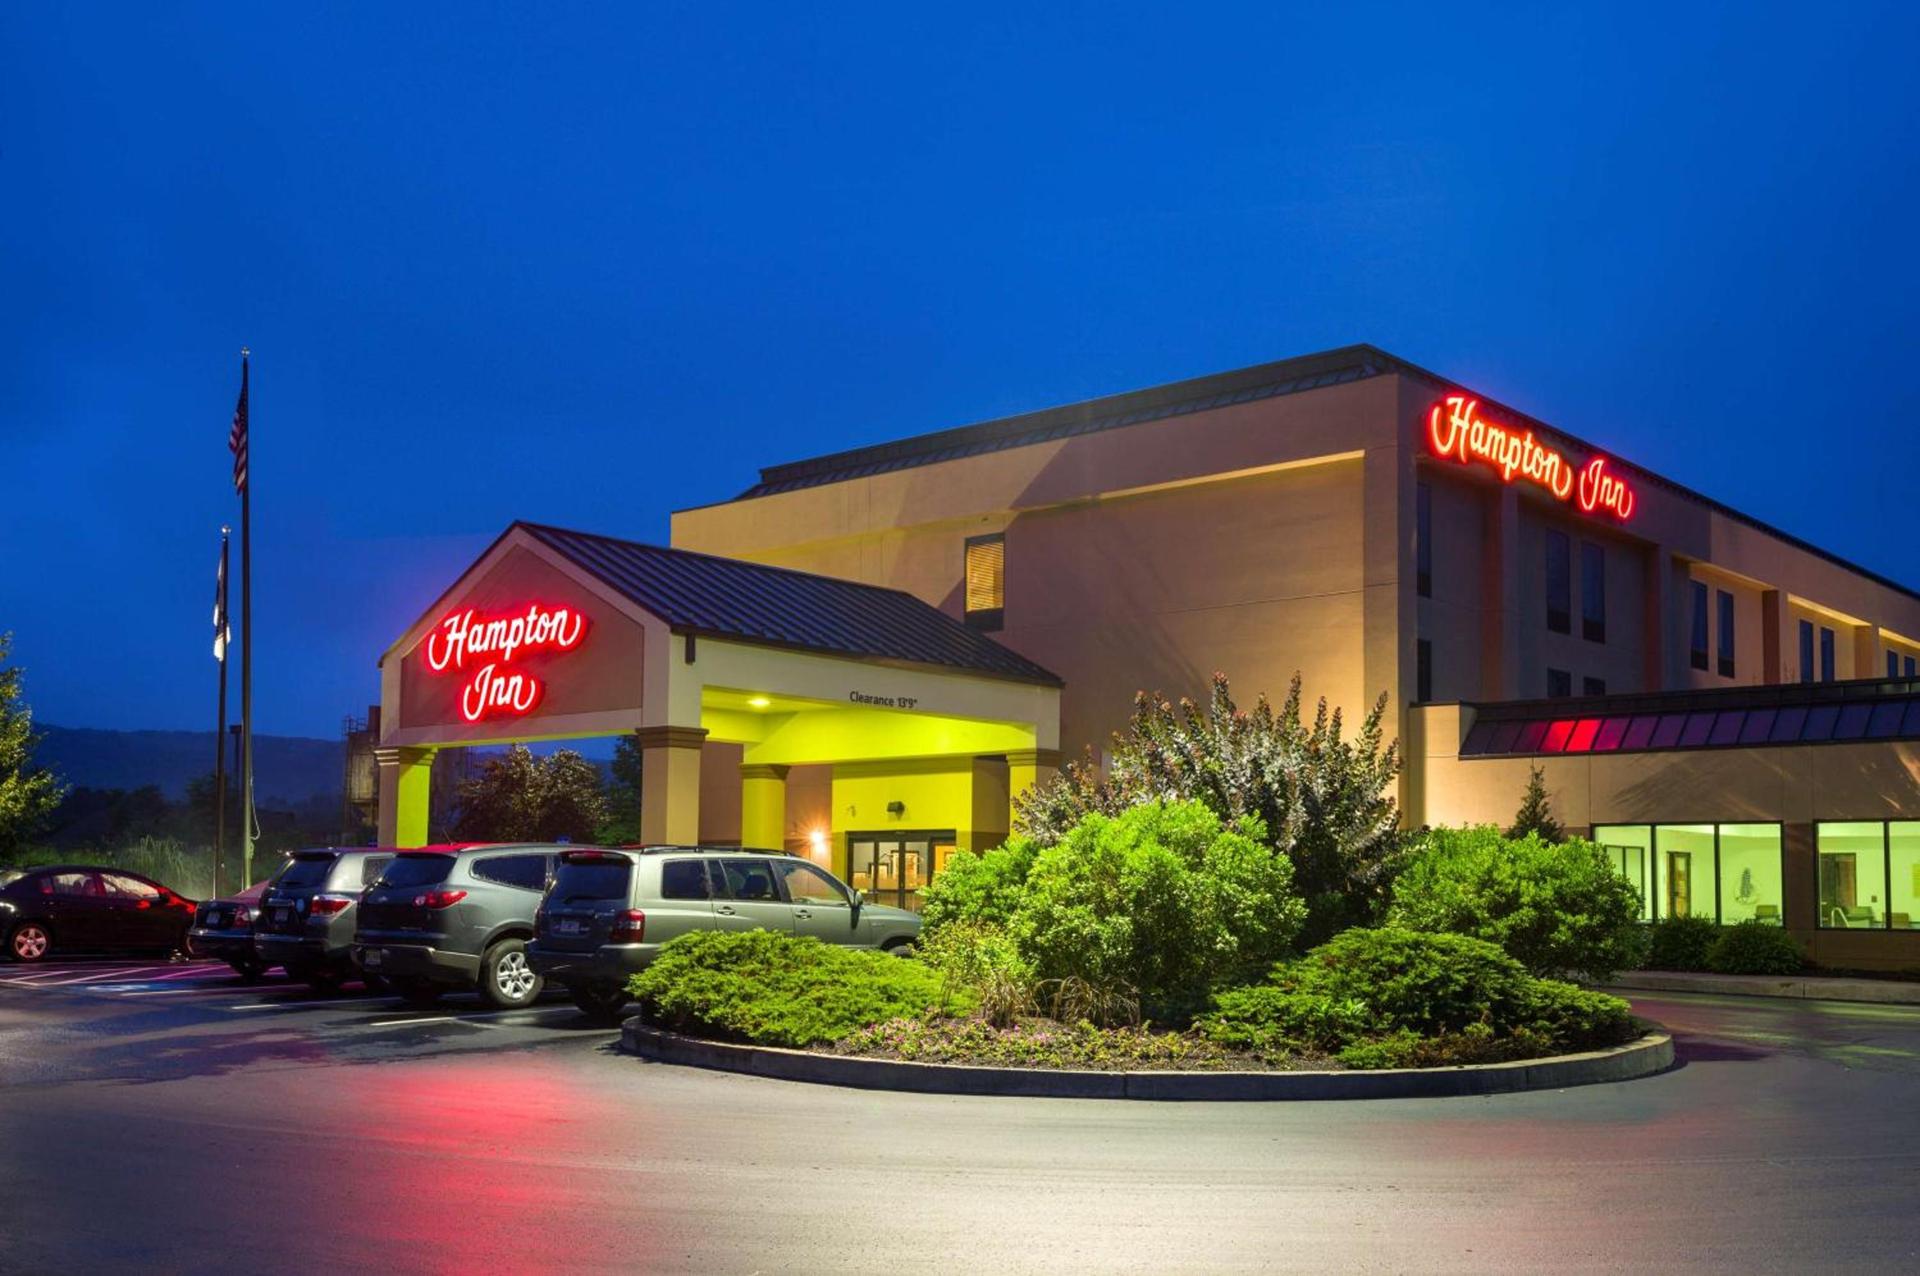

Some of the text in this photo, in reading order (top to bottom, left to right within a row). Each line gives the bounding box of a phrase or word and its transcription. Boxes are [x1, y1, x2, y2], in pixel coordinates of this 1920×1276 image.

[1431, 397, 1633, 518] Hampton Inn
[428, 605, 582, 670] Hampton
[463, 664, 536, 721] Inn
[849, 691, 895, 706] Clearance
